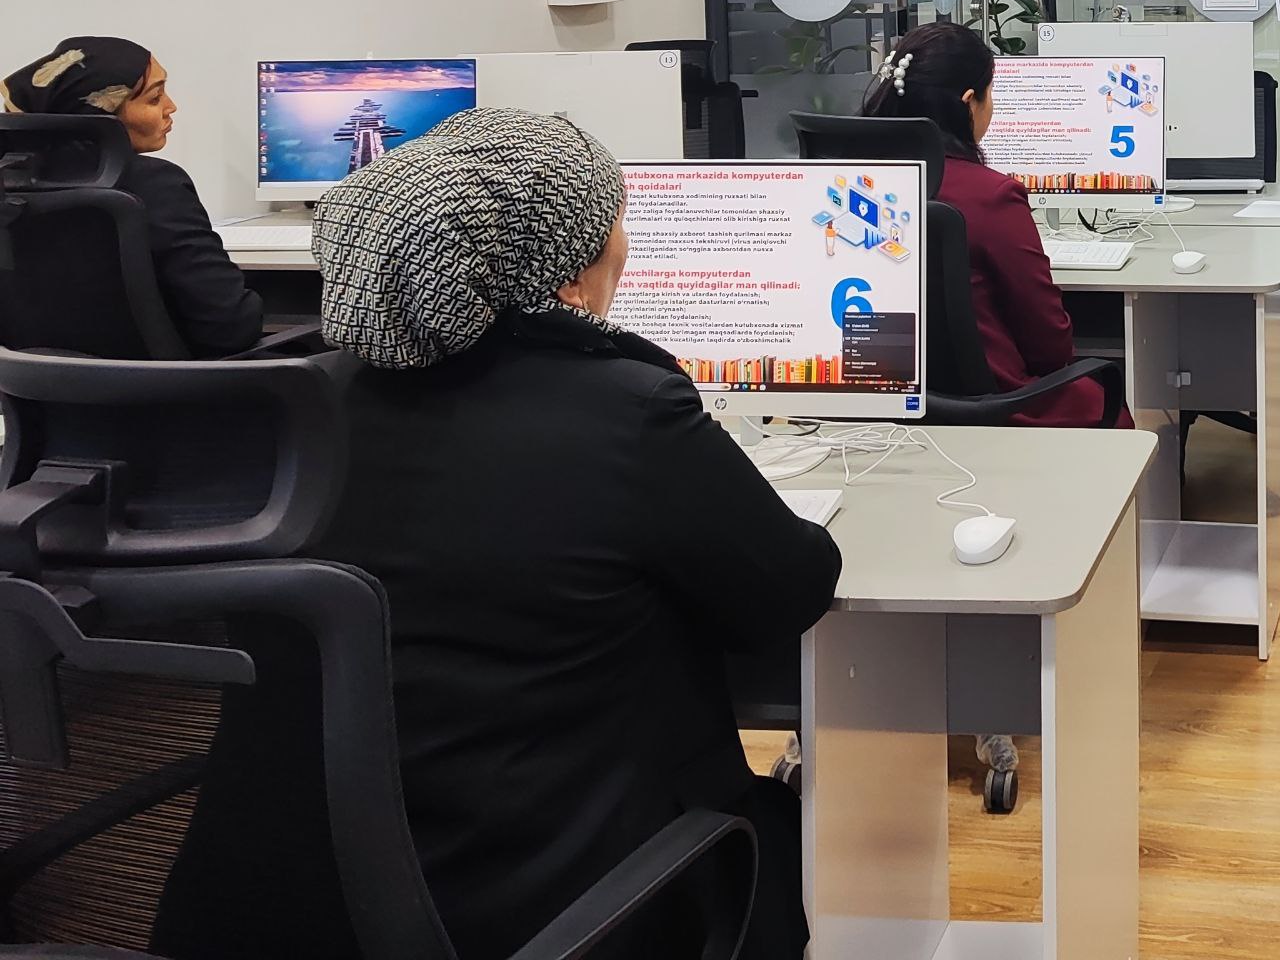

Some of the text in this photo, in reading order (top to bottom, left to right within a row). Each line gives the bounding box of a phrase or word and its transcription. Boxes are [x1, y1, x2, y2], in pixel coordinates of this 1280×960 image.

[1109, 125, 1135, 158] 5
[676, 171, 729, 180] markazida
[731, 171, 804, 181] kompyuterdan
[638, 182, 682, 192] qoidalari
[678, 269, 751, 280] kompyuterdan
[637, 280, 675, 290] vaqtida
[677, 280, 734, 291] quyidagilar
[830, 276, 873, 330] 6
